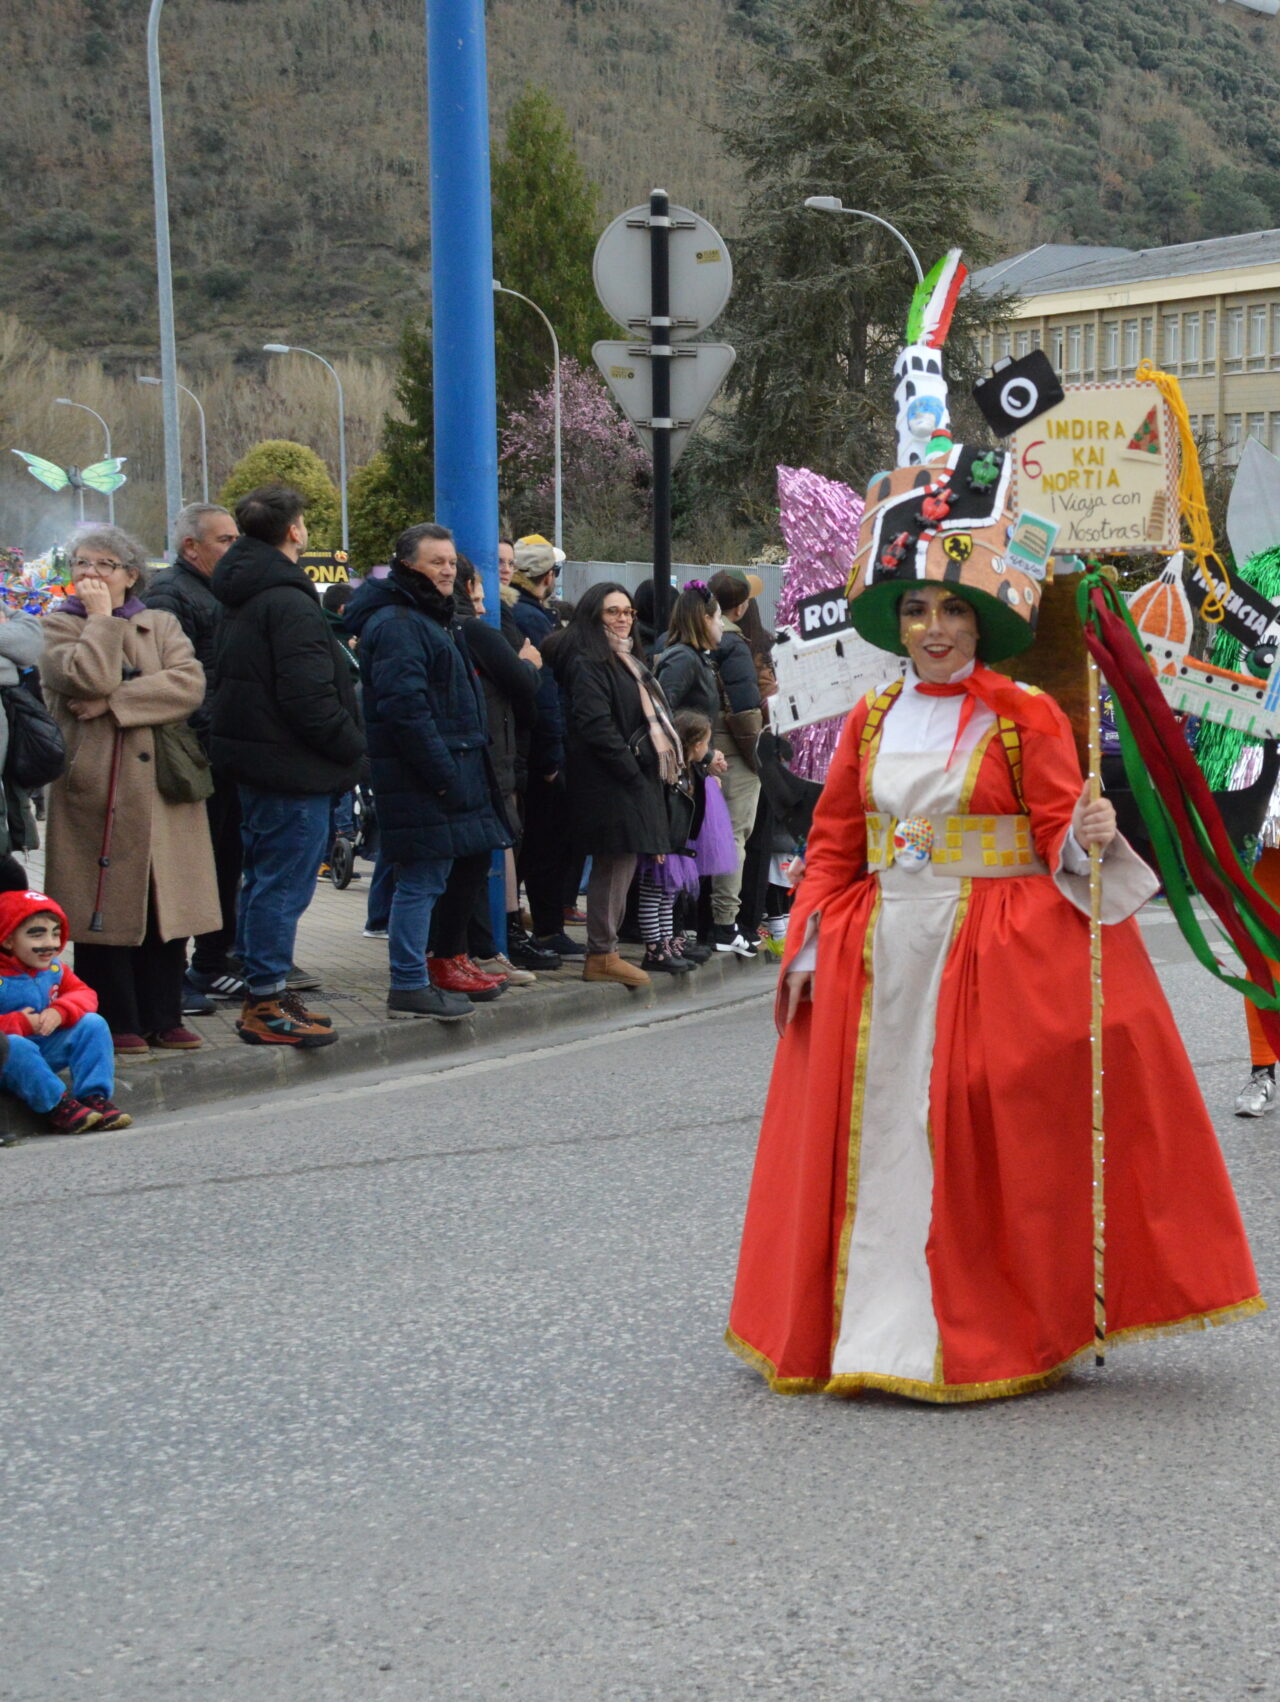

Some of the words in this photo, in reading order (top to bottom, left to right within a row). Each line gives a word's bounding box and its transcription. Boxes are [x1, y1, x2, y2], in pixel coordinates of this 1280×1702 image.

[1046, 419, 1126, 440] INDIRA
[1022, 440, 1046, 479] 6
[1072, 446, 1105, 466] KAI
[1042, 468, 1120, 493] NORTIA
[1112, 492, 1141, 505] con
[1068, 517, 1148, 542] Nosotras!
